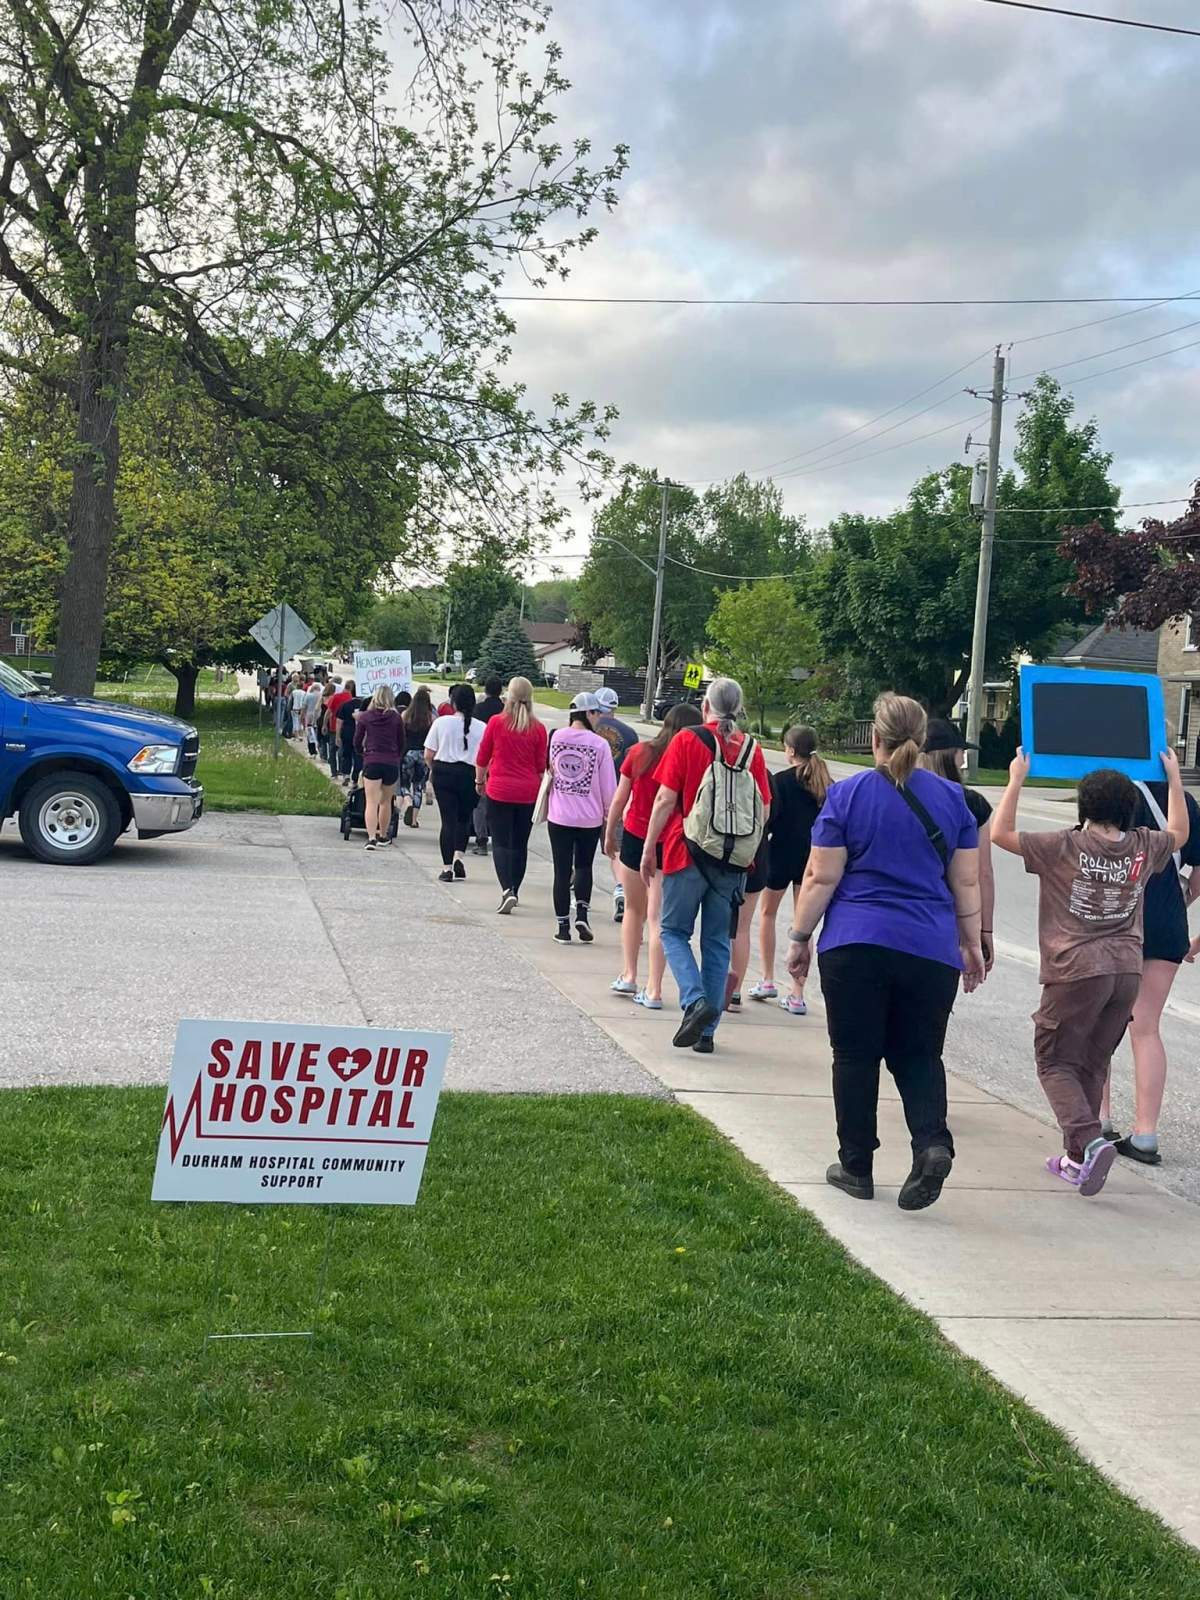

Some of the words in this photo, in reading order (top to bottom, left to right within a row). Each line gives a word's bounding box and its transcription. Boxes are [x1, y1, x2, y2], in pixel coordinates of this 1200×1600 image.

[356, 655, 401, 669] HEALTHCARE
[367, 669, 387, 681] CUTS
[389, 666, 408, 677] HURT
[1079, 851, 1131, 873] ROLLING
[207, 1038, 321, 1082] SAVE
[208, 1083, 415, 1129] HOSPITAL
[182, 1154, 243, 1168] DURHAM
[249, 1156, 317, 1170] HOSPITAL
[322, 1158, 406, 1173] COMMUNITY
[260, 1175, 324, 1189] SUPPORT
